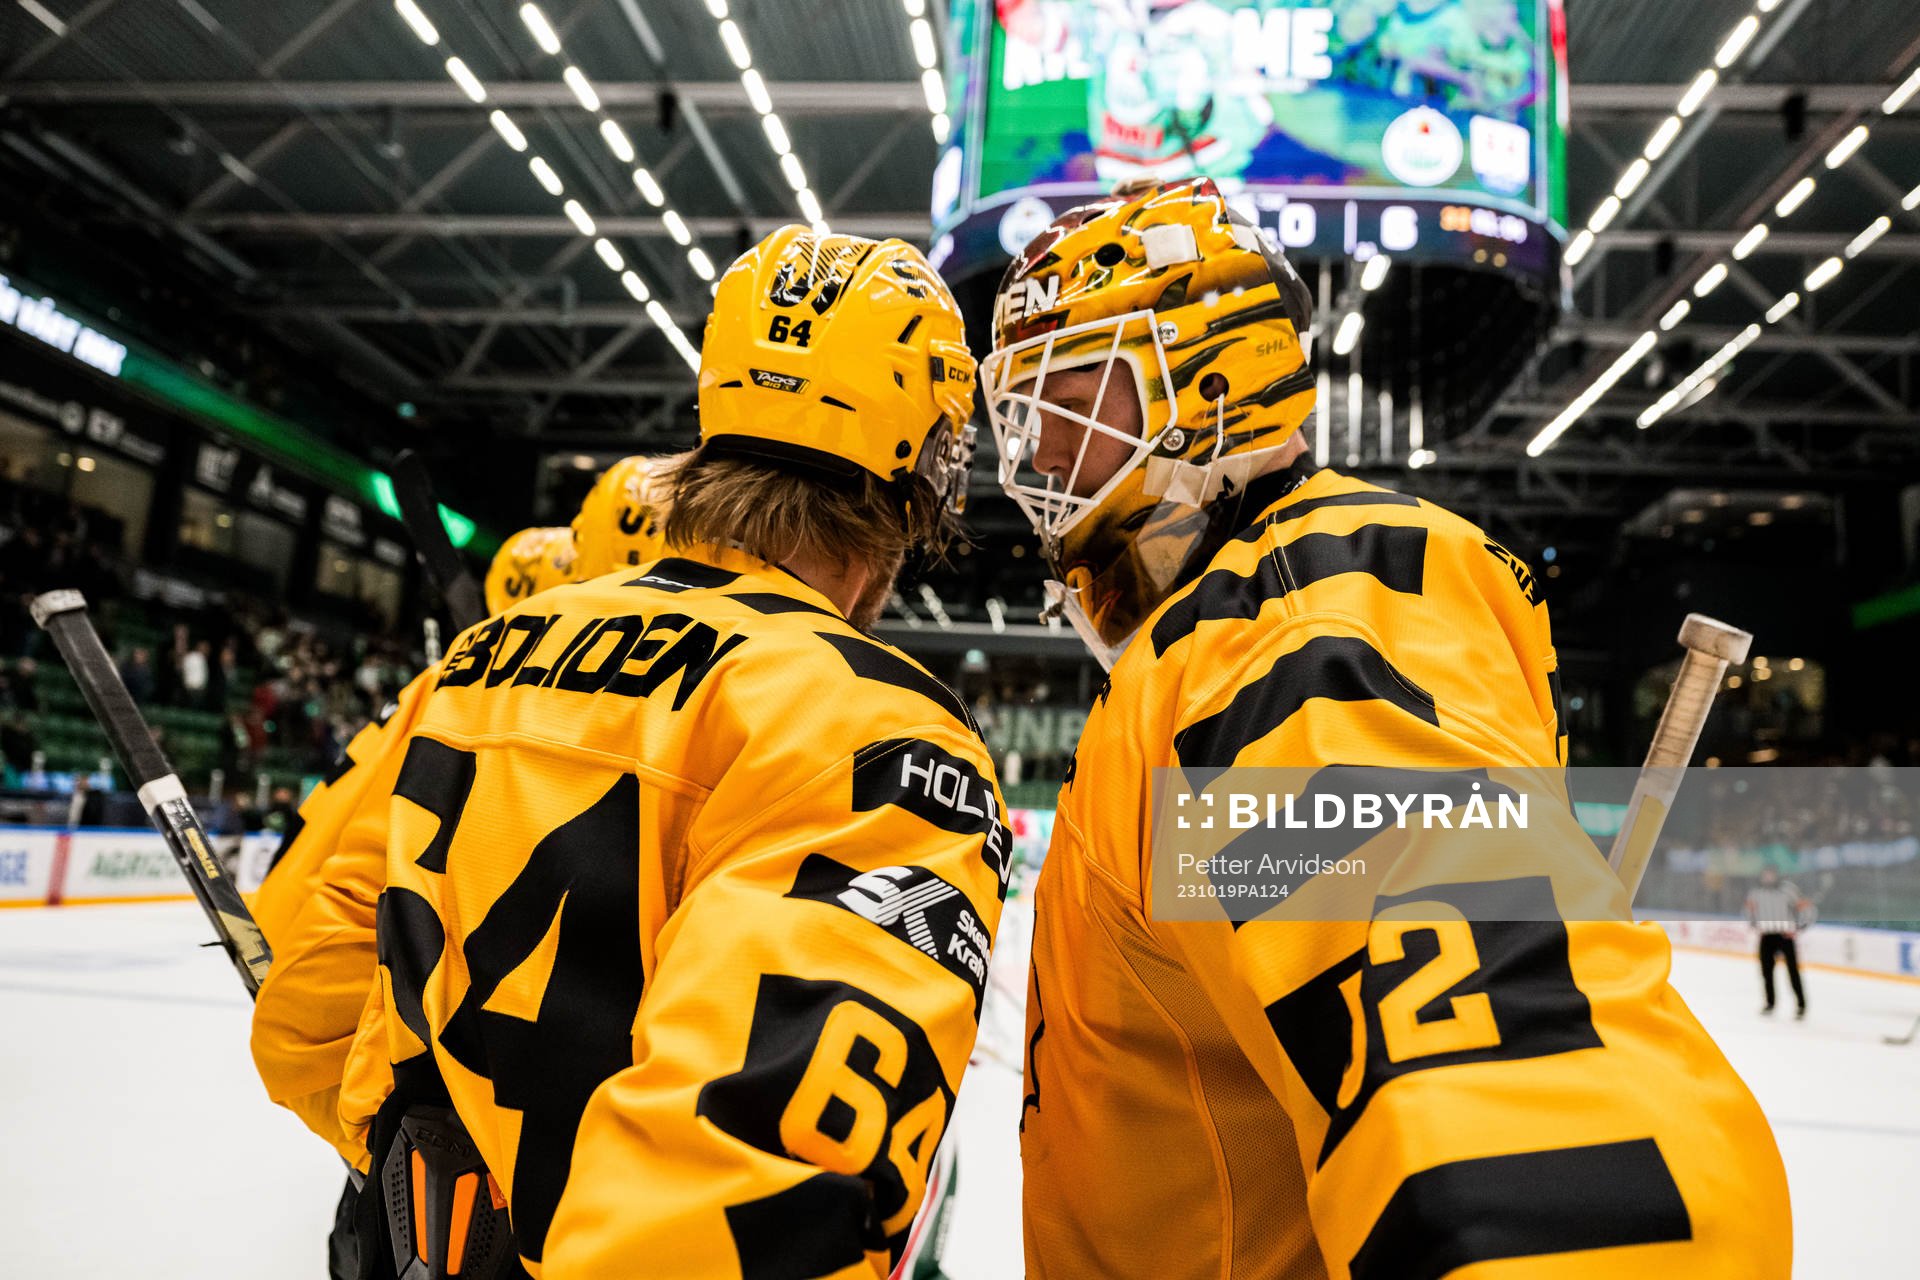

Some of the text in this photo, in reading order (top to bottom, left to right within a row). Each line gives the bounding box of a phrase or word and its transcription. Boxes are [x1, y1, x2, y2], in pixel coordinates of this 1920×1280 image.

[768, 315, 812, 347] 64
[949, 366, 970, 384] CCM
[434, 613, 749, 711] BOLIDEN
[779, 1000, 947, 1237] 64
